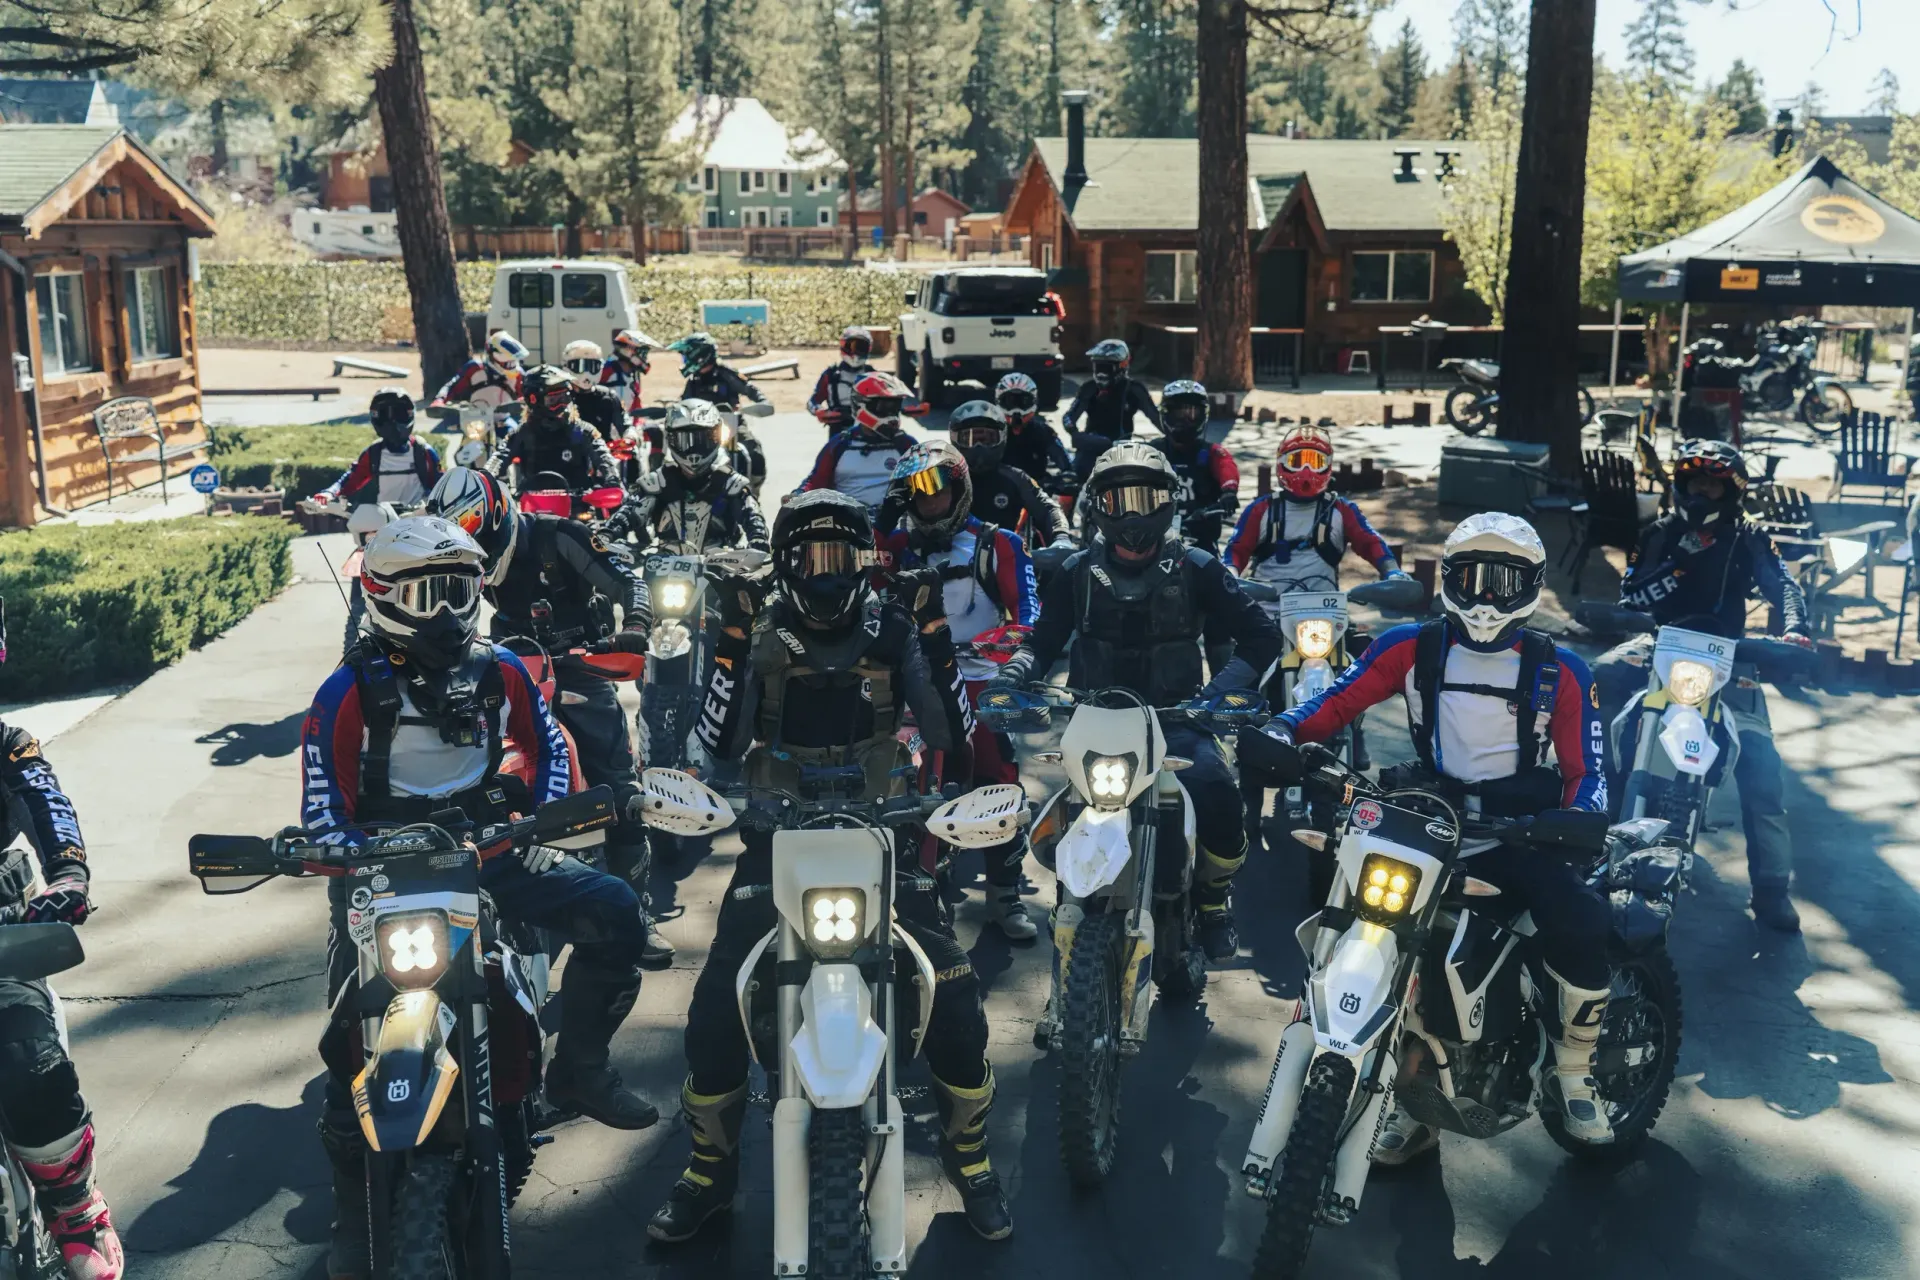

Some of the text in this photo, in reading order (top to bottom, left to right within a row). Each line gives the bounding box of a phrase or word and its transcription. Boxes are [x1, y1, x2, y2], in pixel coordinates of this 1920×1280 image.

[989, 328, 1016, 338] Jeep
[193, 472, 217, 485] ADT
[674, 561, 692, 572] 08
[1323, 598, 1338, 608] 02
[1708, 642, 1725, 656] 06
[1359, 808, 1377, 823] 05
[1329, 1038, 1349, 1051] WLF
[1256, 1039, 1288, 1126] BRIDGESTONE
[1366, 1074, 1396, 1162] BRIDGESTONE
[498, 1151, 511, 1257] BRIDGESTONE
